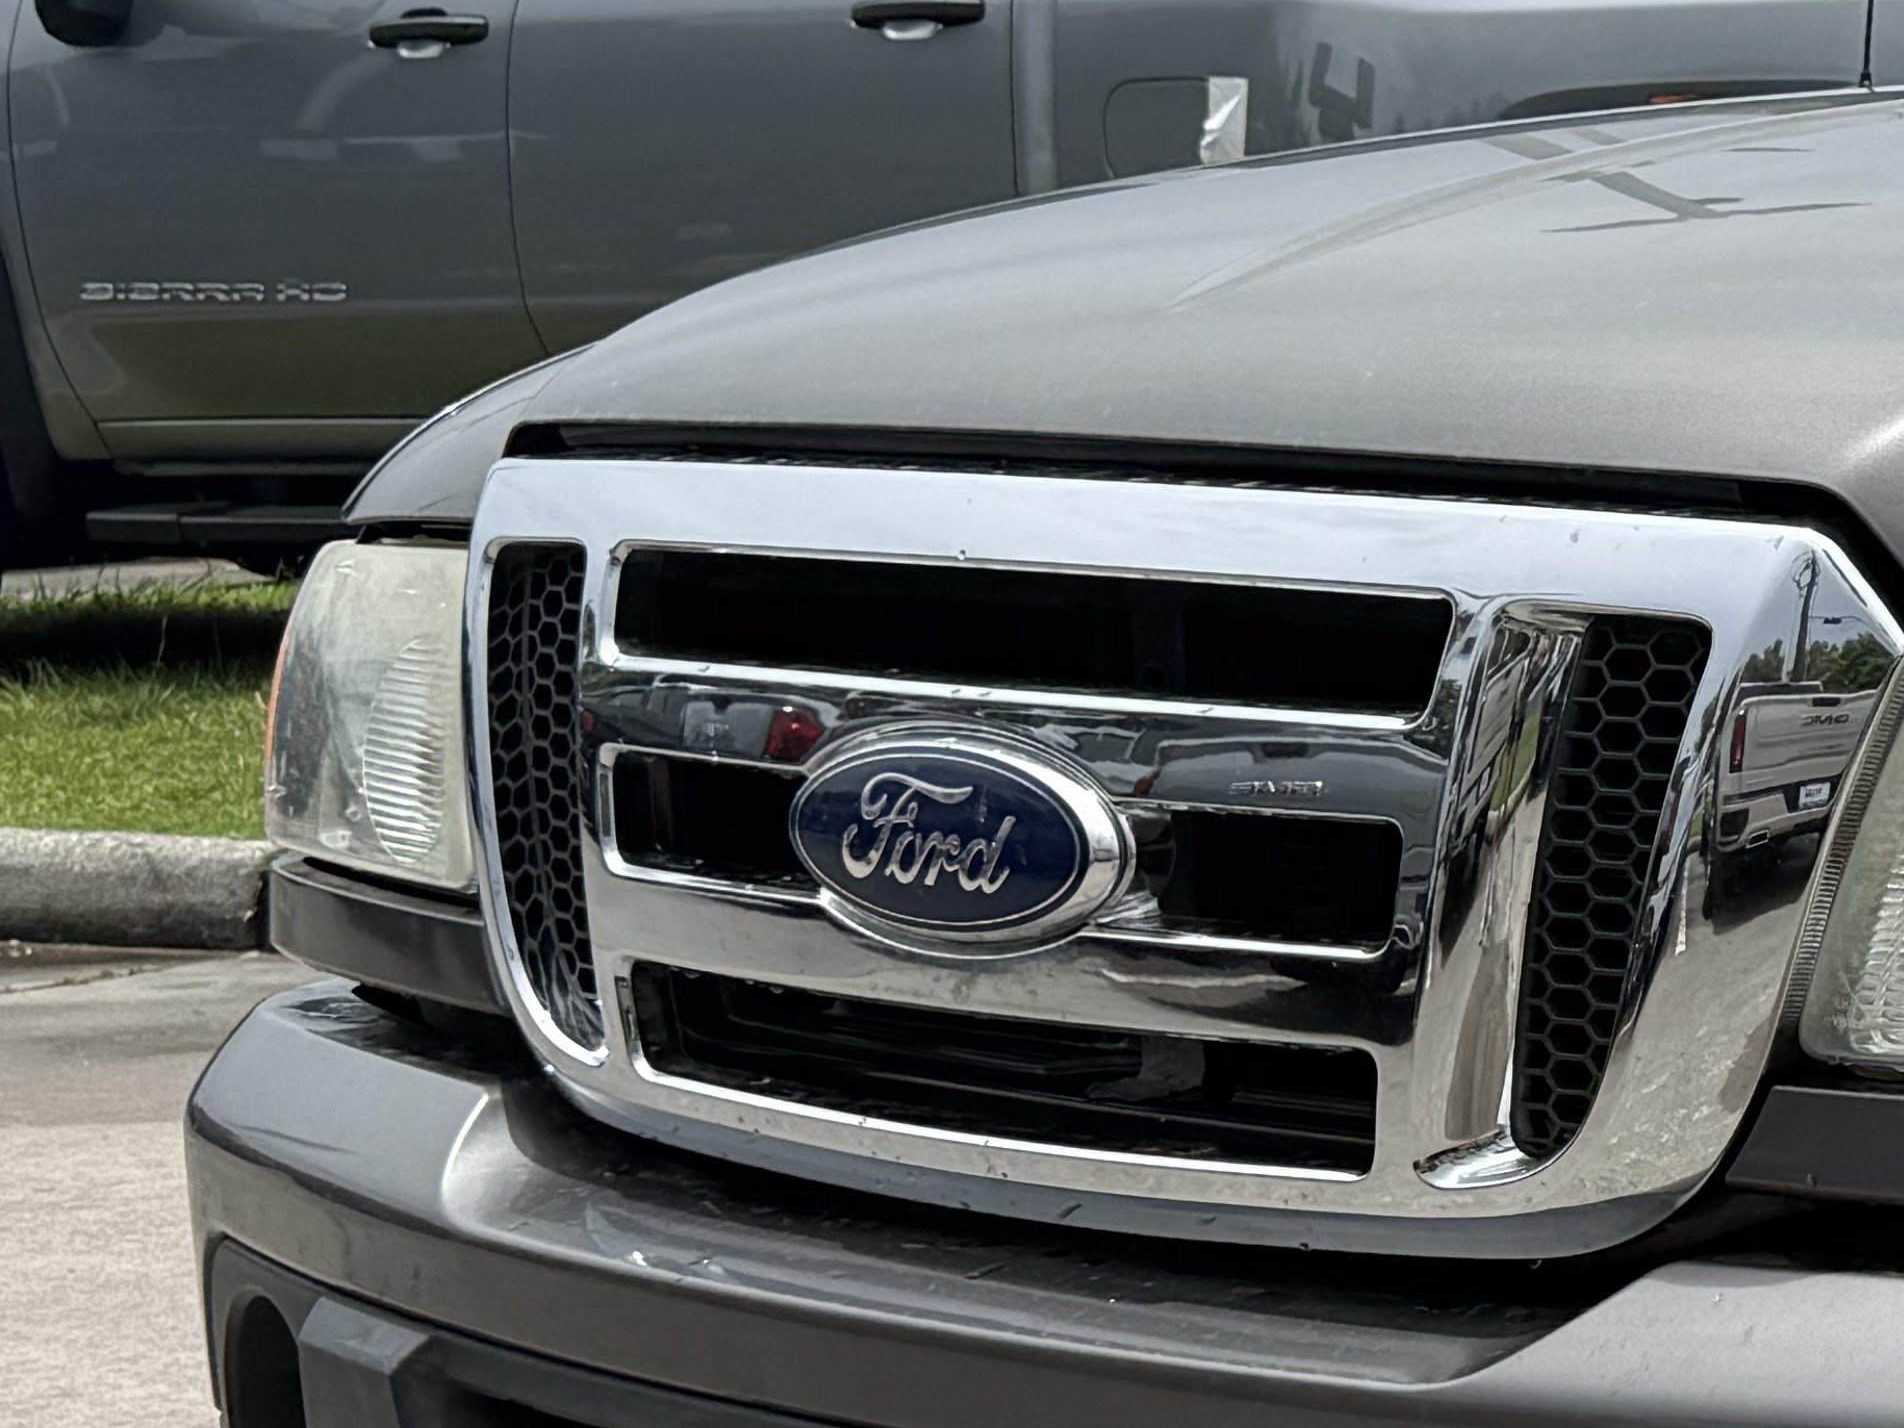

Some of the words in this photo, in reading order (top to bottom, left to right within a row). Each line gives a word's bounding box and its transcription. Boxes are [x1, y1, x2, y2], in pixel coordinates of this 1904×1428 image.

[80, 282, 264, 301] SIERRA
[276, 282, 347, 301] HD
[842, 772, 1016, 894] Ford
